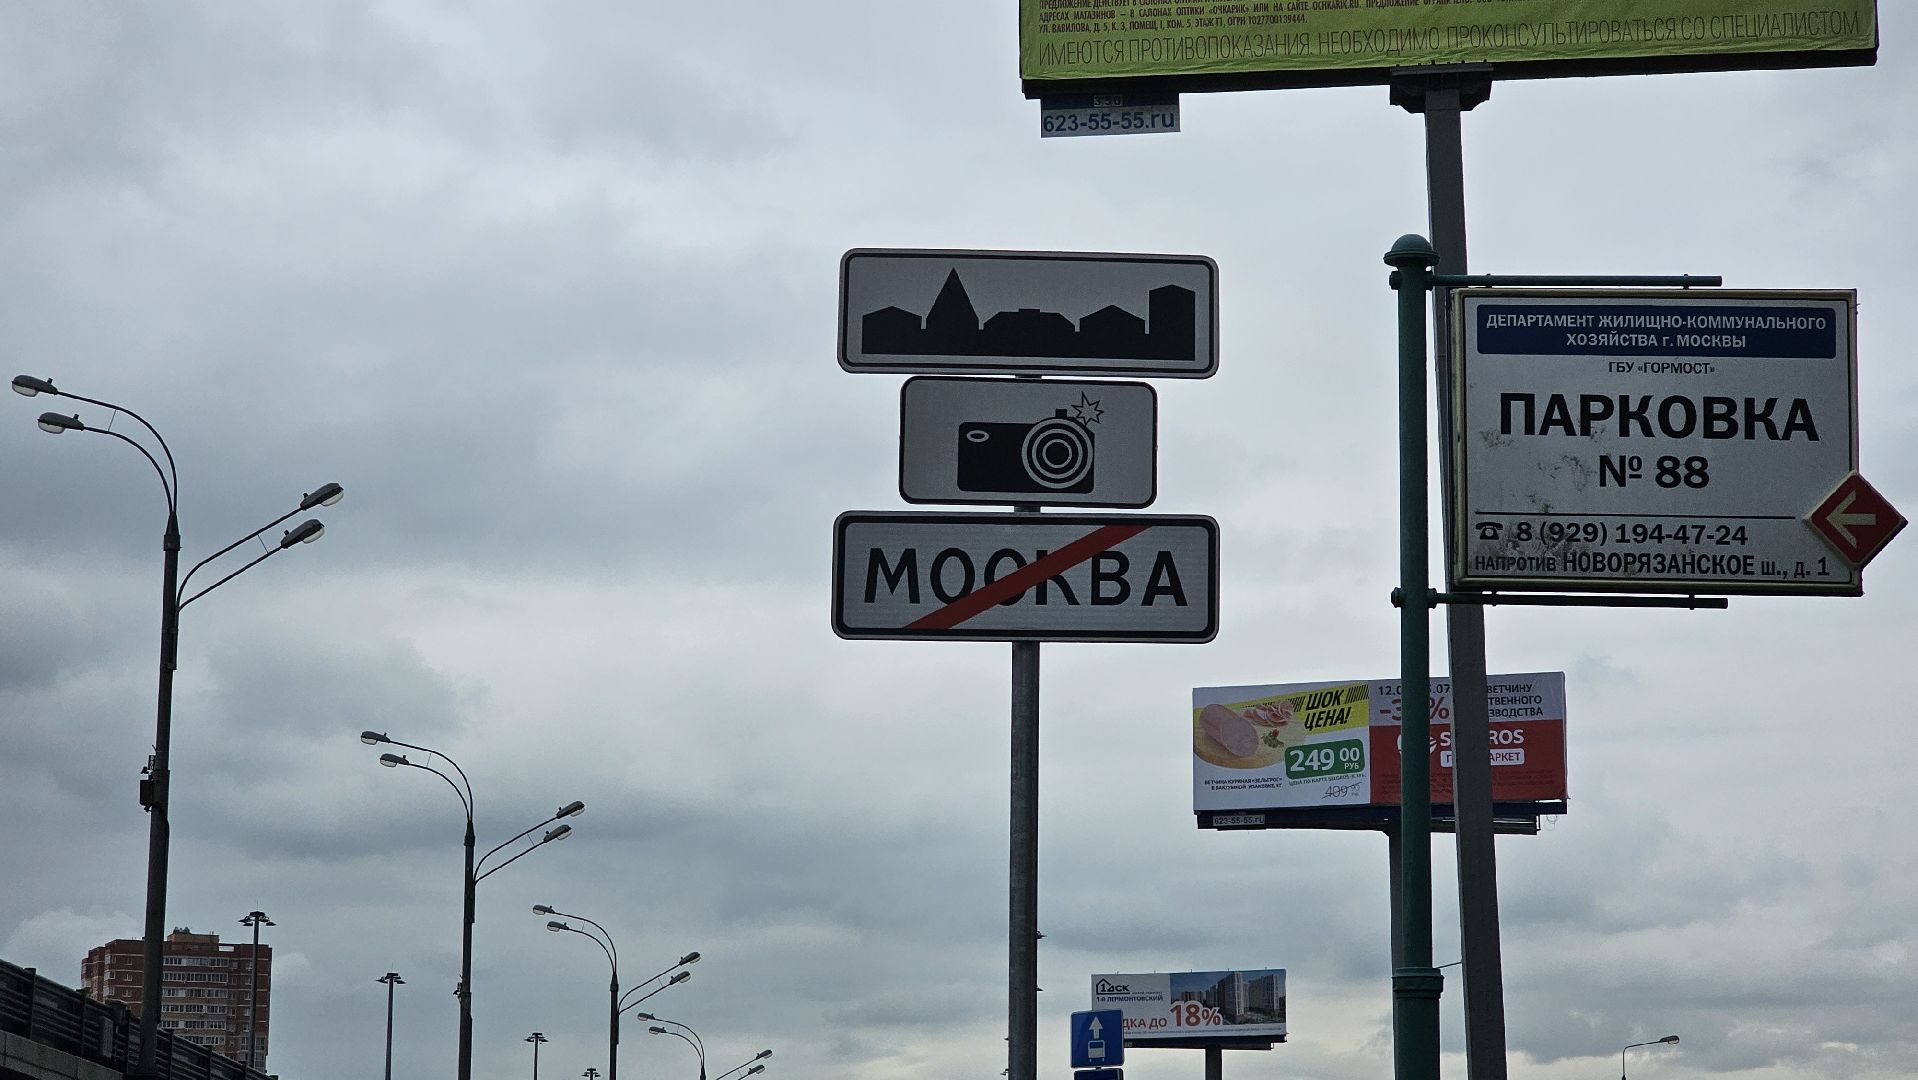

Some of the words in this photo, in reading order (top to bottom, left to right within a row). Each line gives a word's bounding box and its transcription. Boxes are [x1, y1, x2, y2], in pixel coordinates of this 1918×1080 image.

[1040, 11, 1069, 23] АДРЕСАХ
[1073, 10, 1116, 20] МАГАЗИНОВ
[1139, 8, 1172, 18] САЛОНАХ
[1176, 6, 1205, 16] ОПТИКИ
[1209, 4, 1249, 15] «ОЧКАРИК»
[1253, 3, 1269, 13] ИЛИ
[1273, 3, 1284, 12] НА
[1287, 1, 1309, 12] САЙТЕ
[1039, 23, 1050, 33] УЛ.
[1052, 22, 1091, 33] ВАВИЛОВА,
[1167, 19, 1184, 29] КОМ.
[1195, 17, 1214, 28] ЭТАЖ
[1228, 16, 1246, 26] ОГРН
[1040, 39, 1124, 65] ИМЕЮТСЯ
[1129, 33, 1312, 61] ПРОТИВОПОКАЗАНИЯ.
[1319, 27, 1440, 56] НЕОБХОДИМО
[1447, 17, 1676, 48] ПРОКОНСУЛЬТИРОВАТЬСЯ
[1681, 16, 1705, 40] СО
[1710, 10, 1859, 41] СПЕЦИАЛИСТОМ
[1043, 111, 1175, 132] 623-55-55.ru
[1486, 314, 1595, 329] ДЕПАРТАМЕНТ
[1599, 315, 1827, 330] ЖИЛИЩНО-КОММУНАЛЬНОГО
[1566, 330, 1658, 346] ХОЗЯЙСТВА
[1662, 337, 1674, 347] г.
[1676, 334, 1746, 348] МОСКВЫ
[1608, 361, 1635, 373] ГБУ
[1638, 362, 1715, 374] «ГОРМОСТ»
[1500, 392, 1820, 442] ПАРКОВКА
[1599, 455, 1643, 488] №
[1655, 455, 1710, 489] 88
[1516, 521, 1533, 542] 8
[1540, 521, 1607, 546] (929)
[1615, 523, 1749, 545] 194-47-24
[1475, 555, 1557, 572] НАПРОТИВ
[1563, 552, 1755, 576] НОВОРЯЗАНСКОЕ
[1761, 560, 1788, 579] ш.,
[1794, 561, 1811, 579] д.
[1817, 556, 1830, 576] 1
[863, 547, 1188, 607] МОСКВА
[1305, 689, 1345, 711] ШОК
[1378, 685, 1401, 696] 12.0
[1488, 695, 1543, 706] ТВЕННОГО
[1304, 706, 1352, 731] ЦЕНА!
[1489, 706, 1544, 719] ЗВОДСТВА
[1289, 748, 1335, 772] 249
[1339, 747, 1360, 762] 00
[1344, 762, 1360, 771] РУБ
[1123, 1019, 1149, 1031] ДКА
[1149, 1018, 1168, 1031] ДО
[1169, 1003, 1222, 1028] 18%
